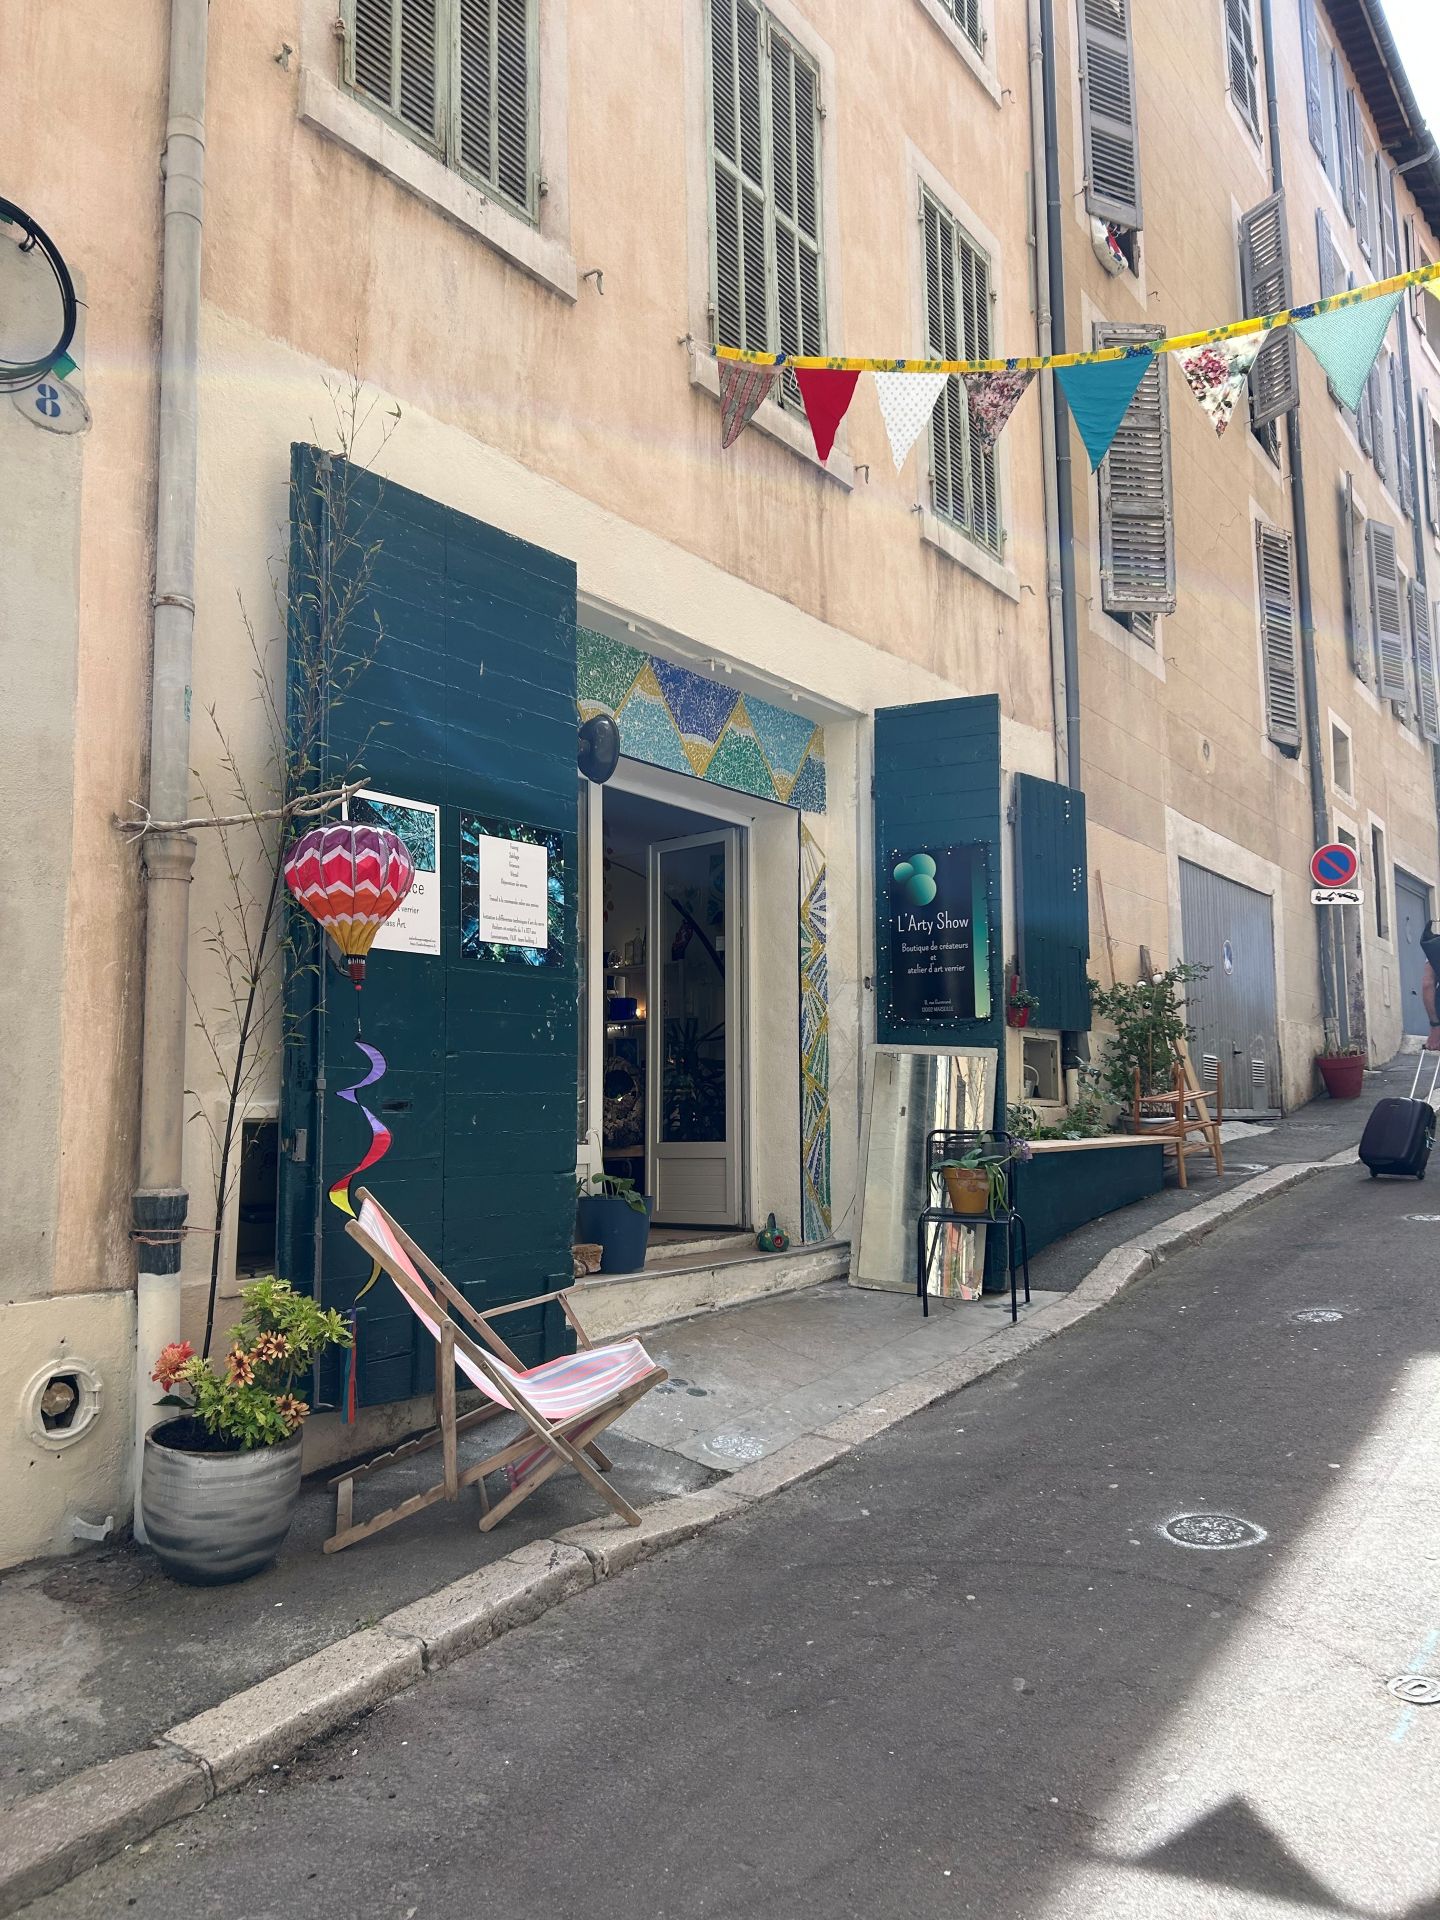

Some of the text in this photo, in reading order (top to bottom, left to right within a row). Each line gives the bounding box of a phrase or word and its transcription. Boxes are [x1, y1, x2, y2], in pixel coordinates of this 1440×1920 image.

[36, 383, 61, 417] 8
[898, 910, 969, 935] L'Arty Show
[901, 942, 929, 954] Boutique
[931, 940, 938, 951] de
[907, 962, 965, 974] atelier d'art verrier
